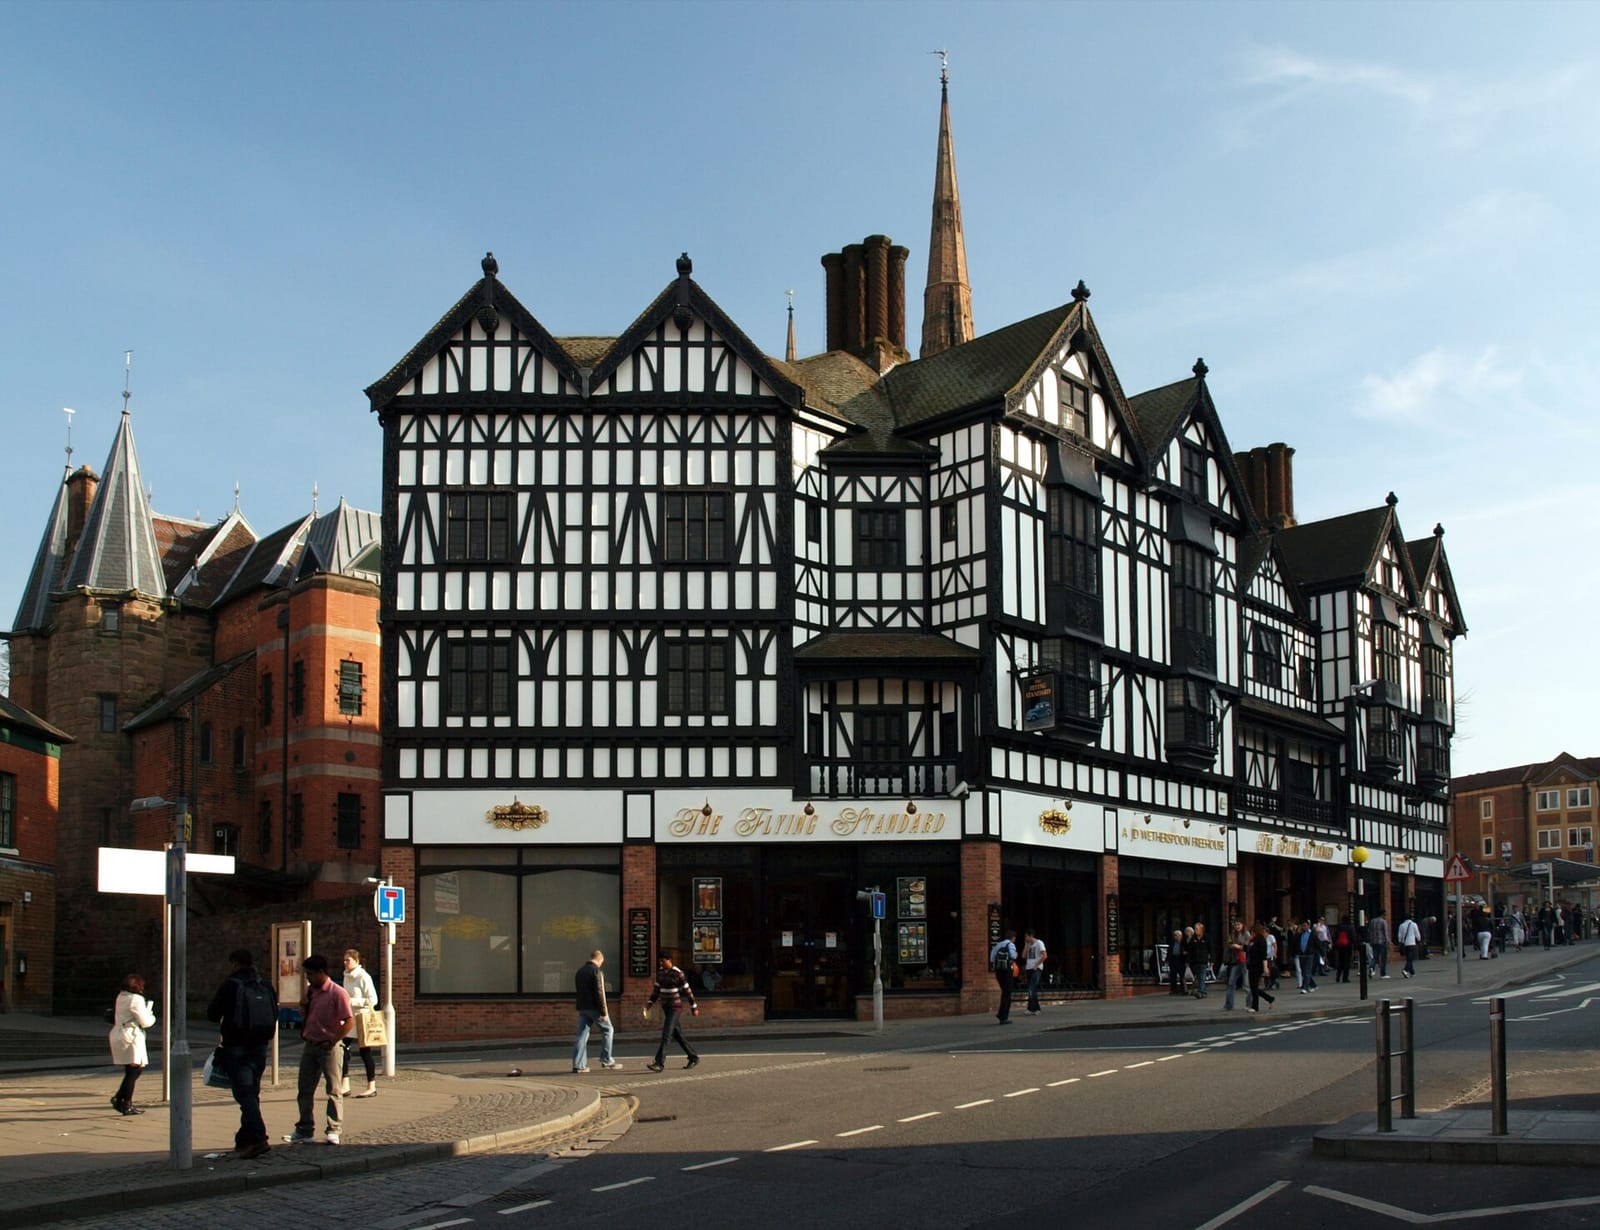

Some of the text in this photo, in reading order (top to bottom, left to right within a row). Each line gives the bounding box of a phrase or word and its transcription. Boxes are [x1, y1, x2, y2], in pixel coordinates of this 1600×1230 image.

[669, 807, 946, 838] THE FLYING STANDARD
[1121, 826, 1128, 838] A
[1139, 829, 1191, 846] WETHERSPOON
[1191, 836, 1225, 851] FREEHOUSE
